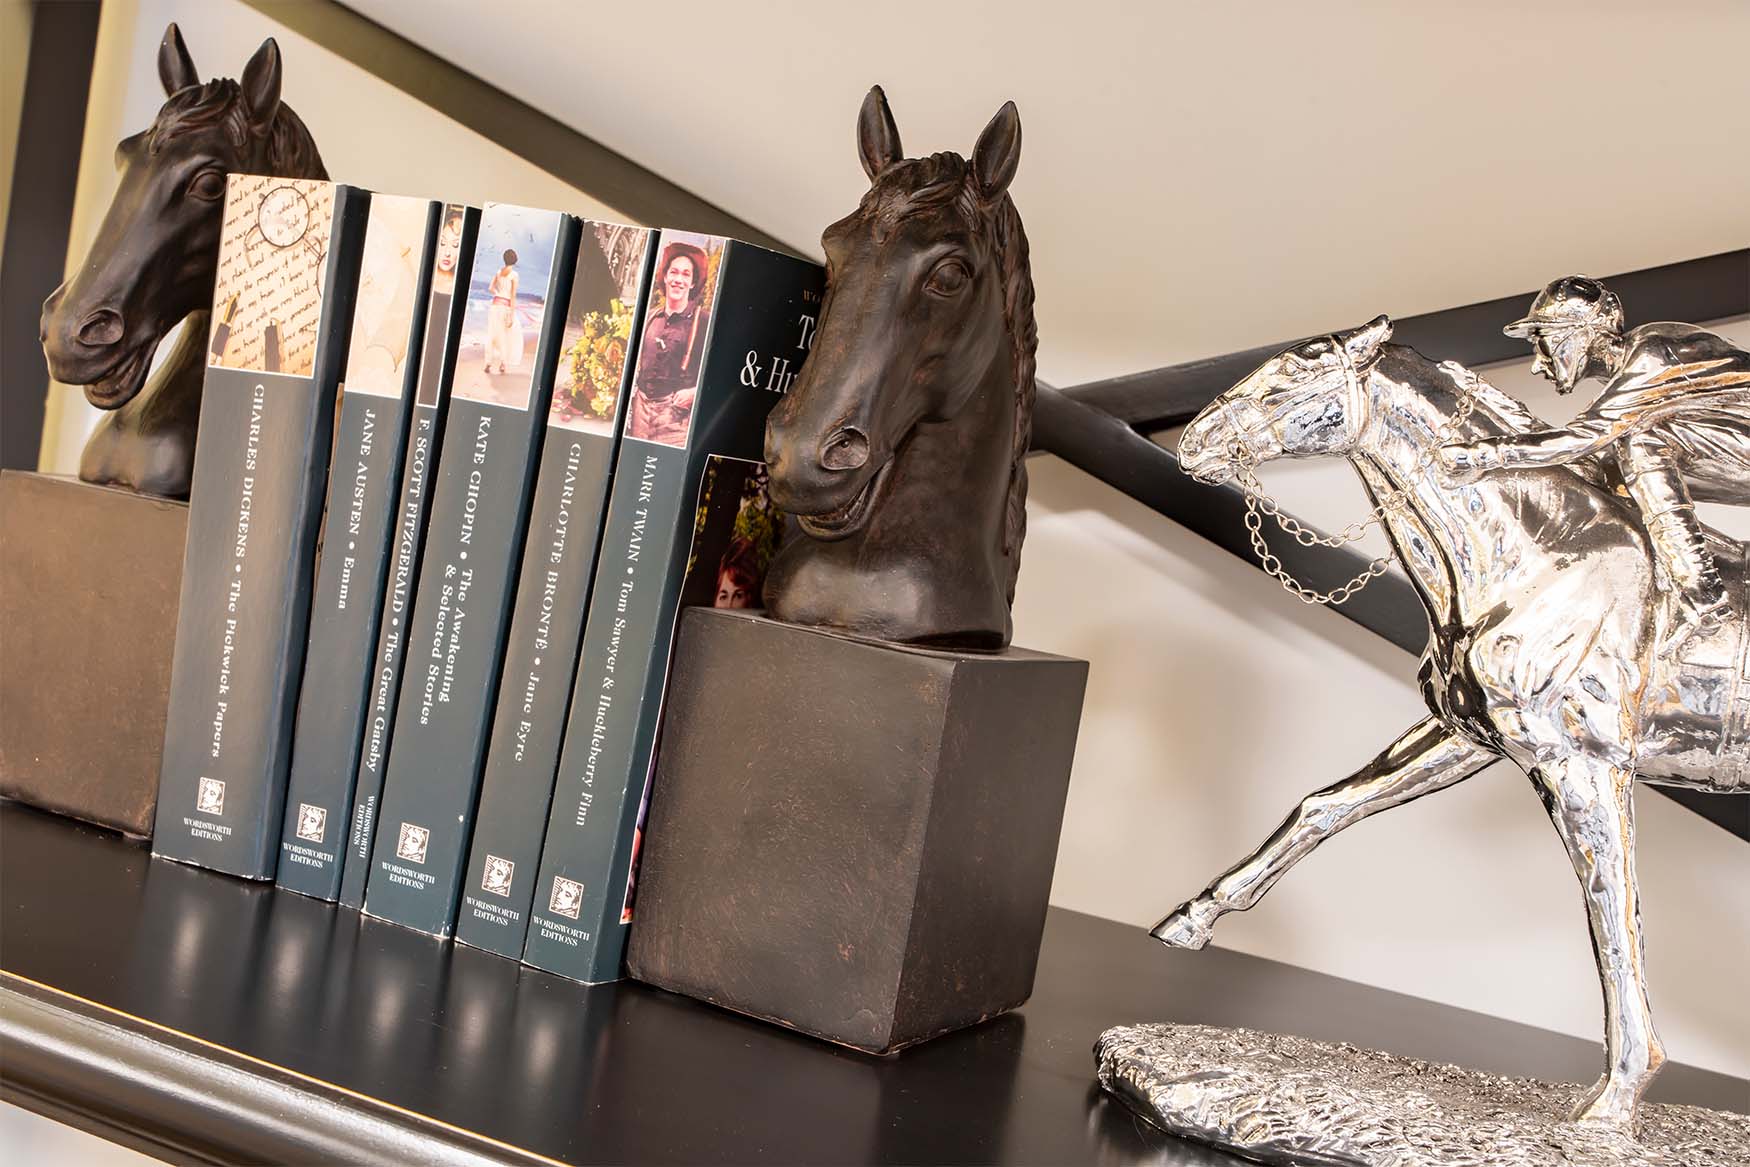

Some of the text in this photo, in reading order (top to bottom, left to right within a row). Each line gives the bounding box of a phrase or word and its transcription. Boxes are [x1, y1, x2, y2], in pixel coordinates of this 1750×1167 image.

[739, 350, 763, 388] &
[338, 409, 376, 610] JANE AUSTEN Emma
[550, 442, 582, 565] CHARLOTTE
[211, 383, 265, 759] CHARLES DICKENS The Pickwick Papers
[438, 415, 492, 703] KATE CHOPIN The Awakening
[365, 419, 431, 773] F. SCOTT FITZGERALD The Great Gatsby
[420, 564, 457, 726] & Selected Stories
[575, 455, 658, 827] MARK TWAIN Tom Sawyer & Huckleberry Finn
[523, 672, 541, 714] Jane
[515, 720, 532, 762] Eyre
[183, 817, 232, 836] WORDSWORTH
[190, 828, 223, 842] EDITIONS
[353, 804, 365, 846] EDITIONS
[358, 795, 375, 858] WORDSWORTH
[283, 842, 334, 863] WORDSWORTH
[290, 853, 323, 868] EDITIONS
[381, 861, 435, 885] WORDSWORTH
[389, 873, 425, 890] EDITIONS
[466, 896, 520, 921] WORDSWORTH
[473, 908, 509, 927] EDITIONS
[533, 915, 590, 942] WORDSWORTH
[540, 928, 579, 947] EDITIONS
